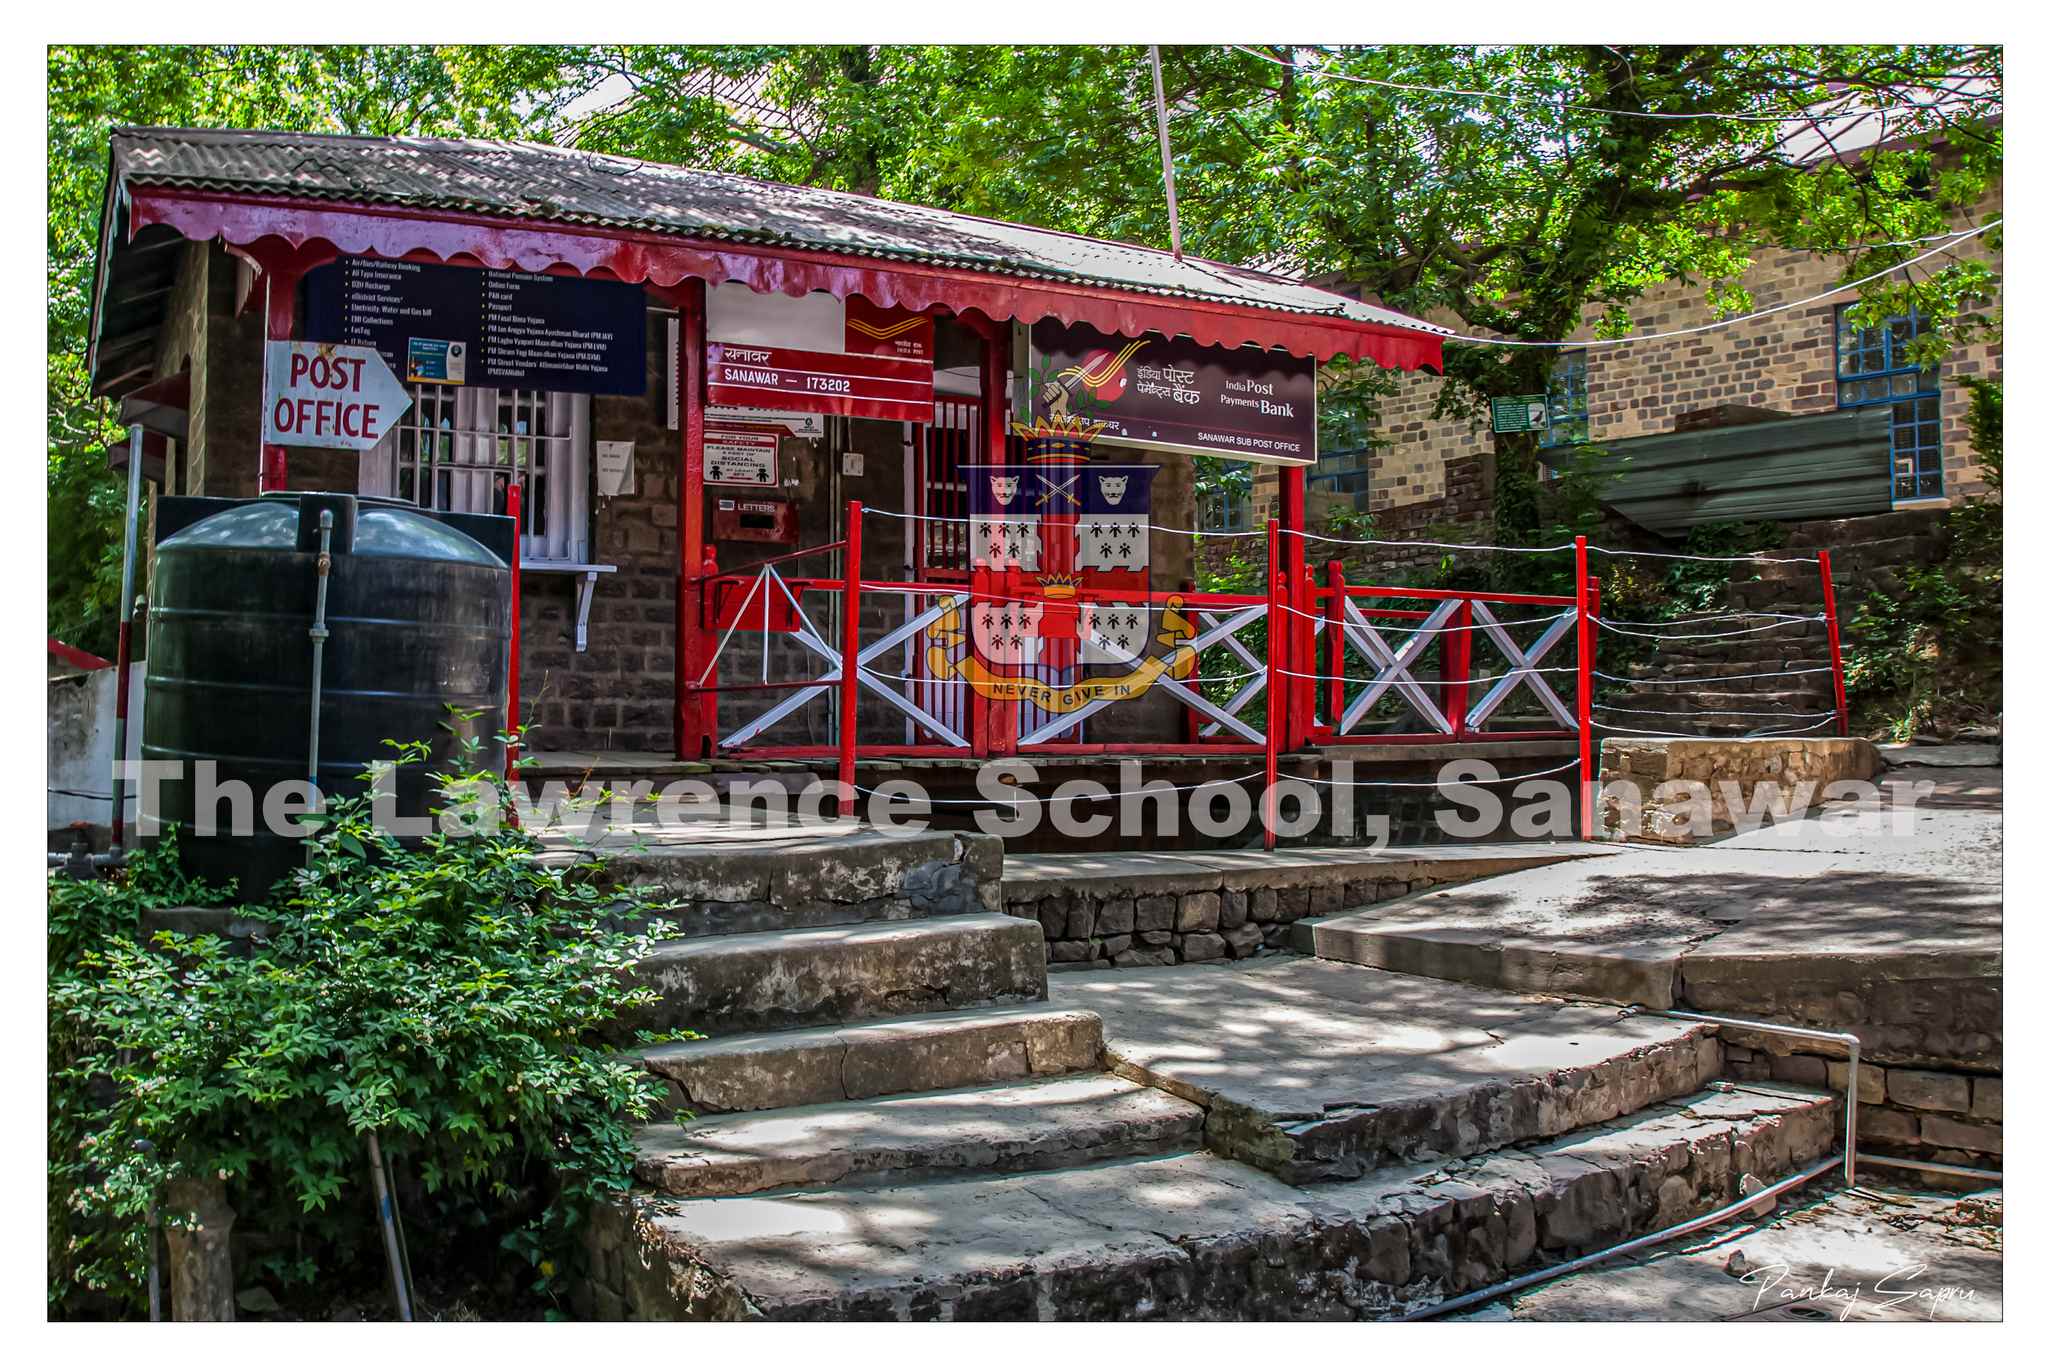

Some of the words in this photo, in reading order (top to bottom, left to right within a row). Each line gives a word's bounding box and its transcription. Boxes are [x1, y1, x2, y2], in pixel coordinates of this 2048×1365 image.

[290, 353, 367, 393] POST
[724, 368, 779, 386] SANAWAR
[806, 376, 850, 392] 173202
[1225, 380, 1246, 392] India
[1246, 379, 1274, 396] Post
[1220, 393, 1260, 409] Payments
[1260, 399, 1295, 418] Bank
[273, 397, 380, 439] OFFICE
[1197, 432, 1235, 444] SANAWAR
[1236, 436, 1252, 447] SUB
[1253, 438, 1273, 449] POST
[1274, 441, 1302, 452] OFFICE
[711, 460, 766, 468] DISTANCING
[738, 503, 776, 513] LETTERS
